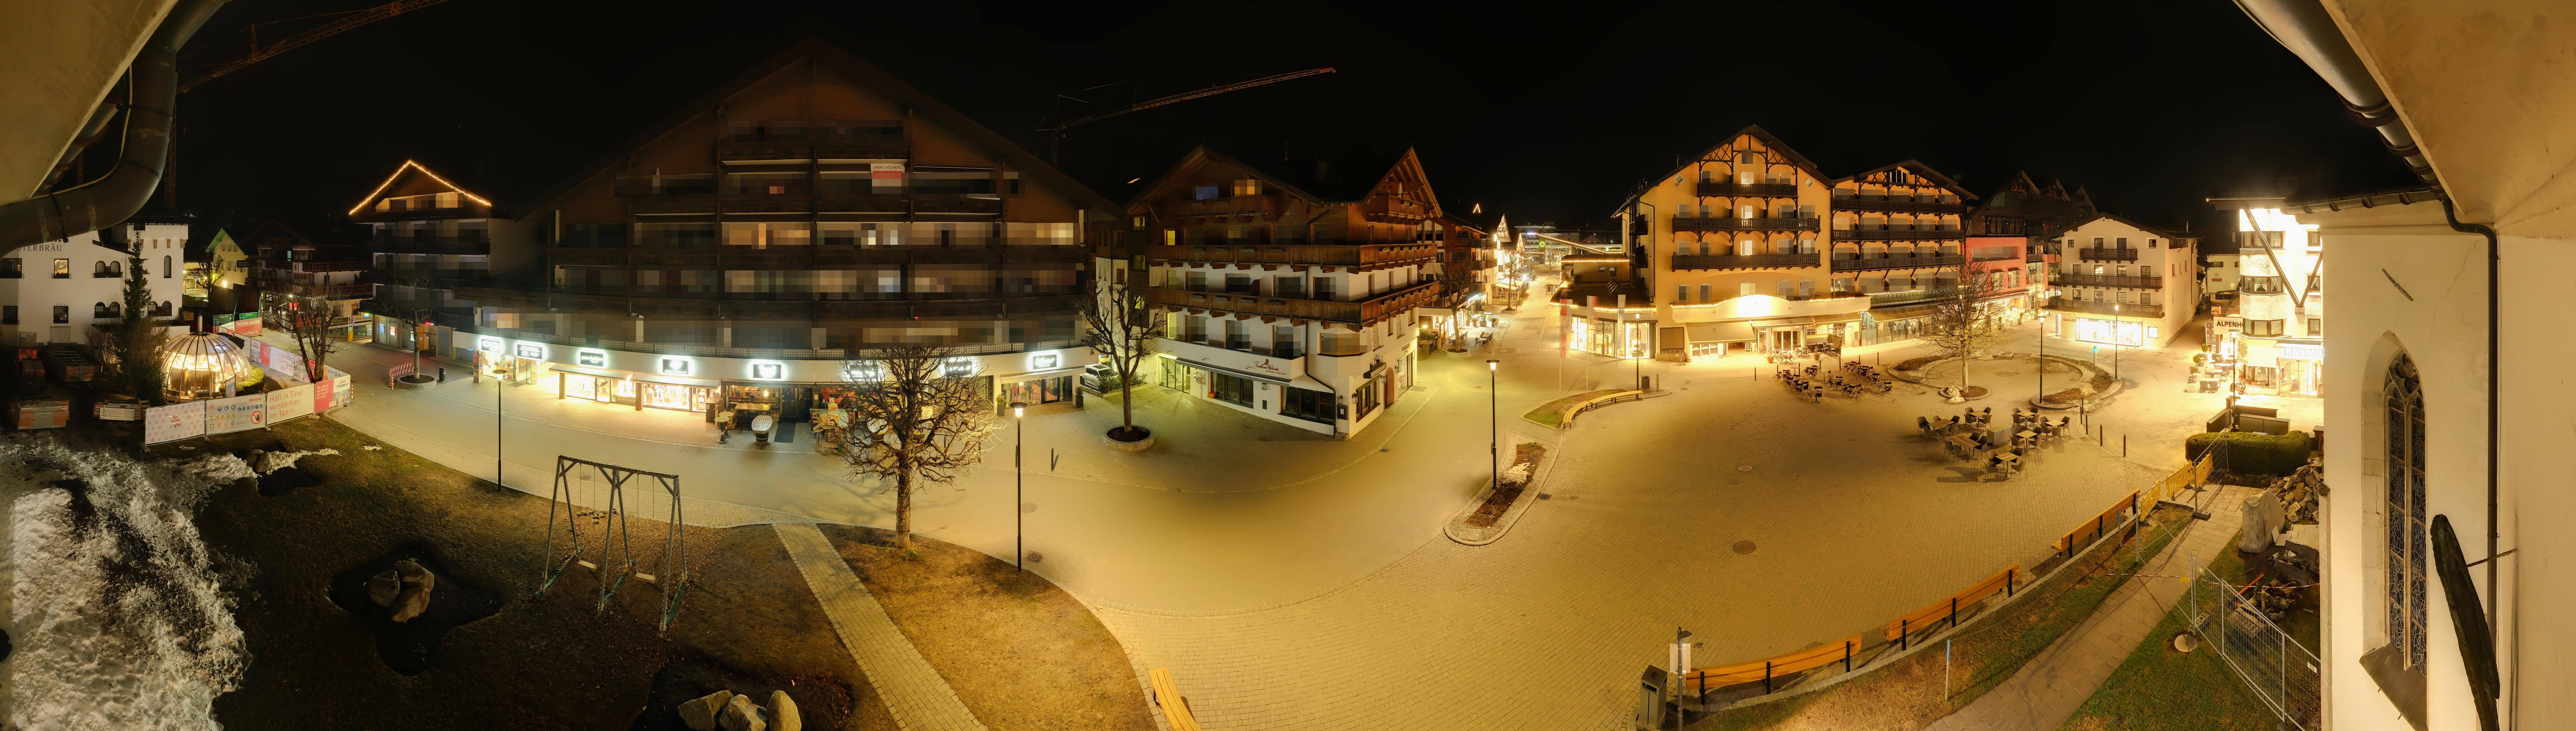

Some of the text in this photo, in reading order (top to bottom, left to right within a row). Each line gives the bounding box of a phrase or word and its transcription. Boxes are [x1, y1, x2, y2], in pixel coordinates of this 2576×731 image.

[1402, 343, 1410, 351] SAILER
[1371, 364, 1385, 377] RESTAURANT
[270, 394, 281, 402] Hall
[269, 400, 301, 411] verstärken.
